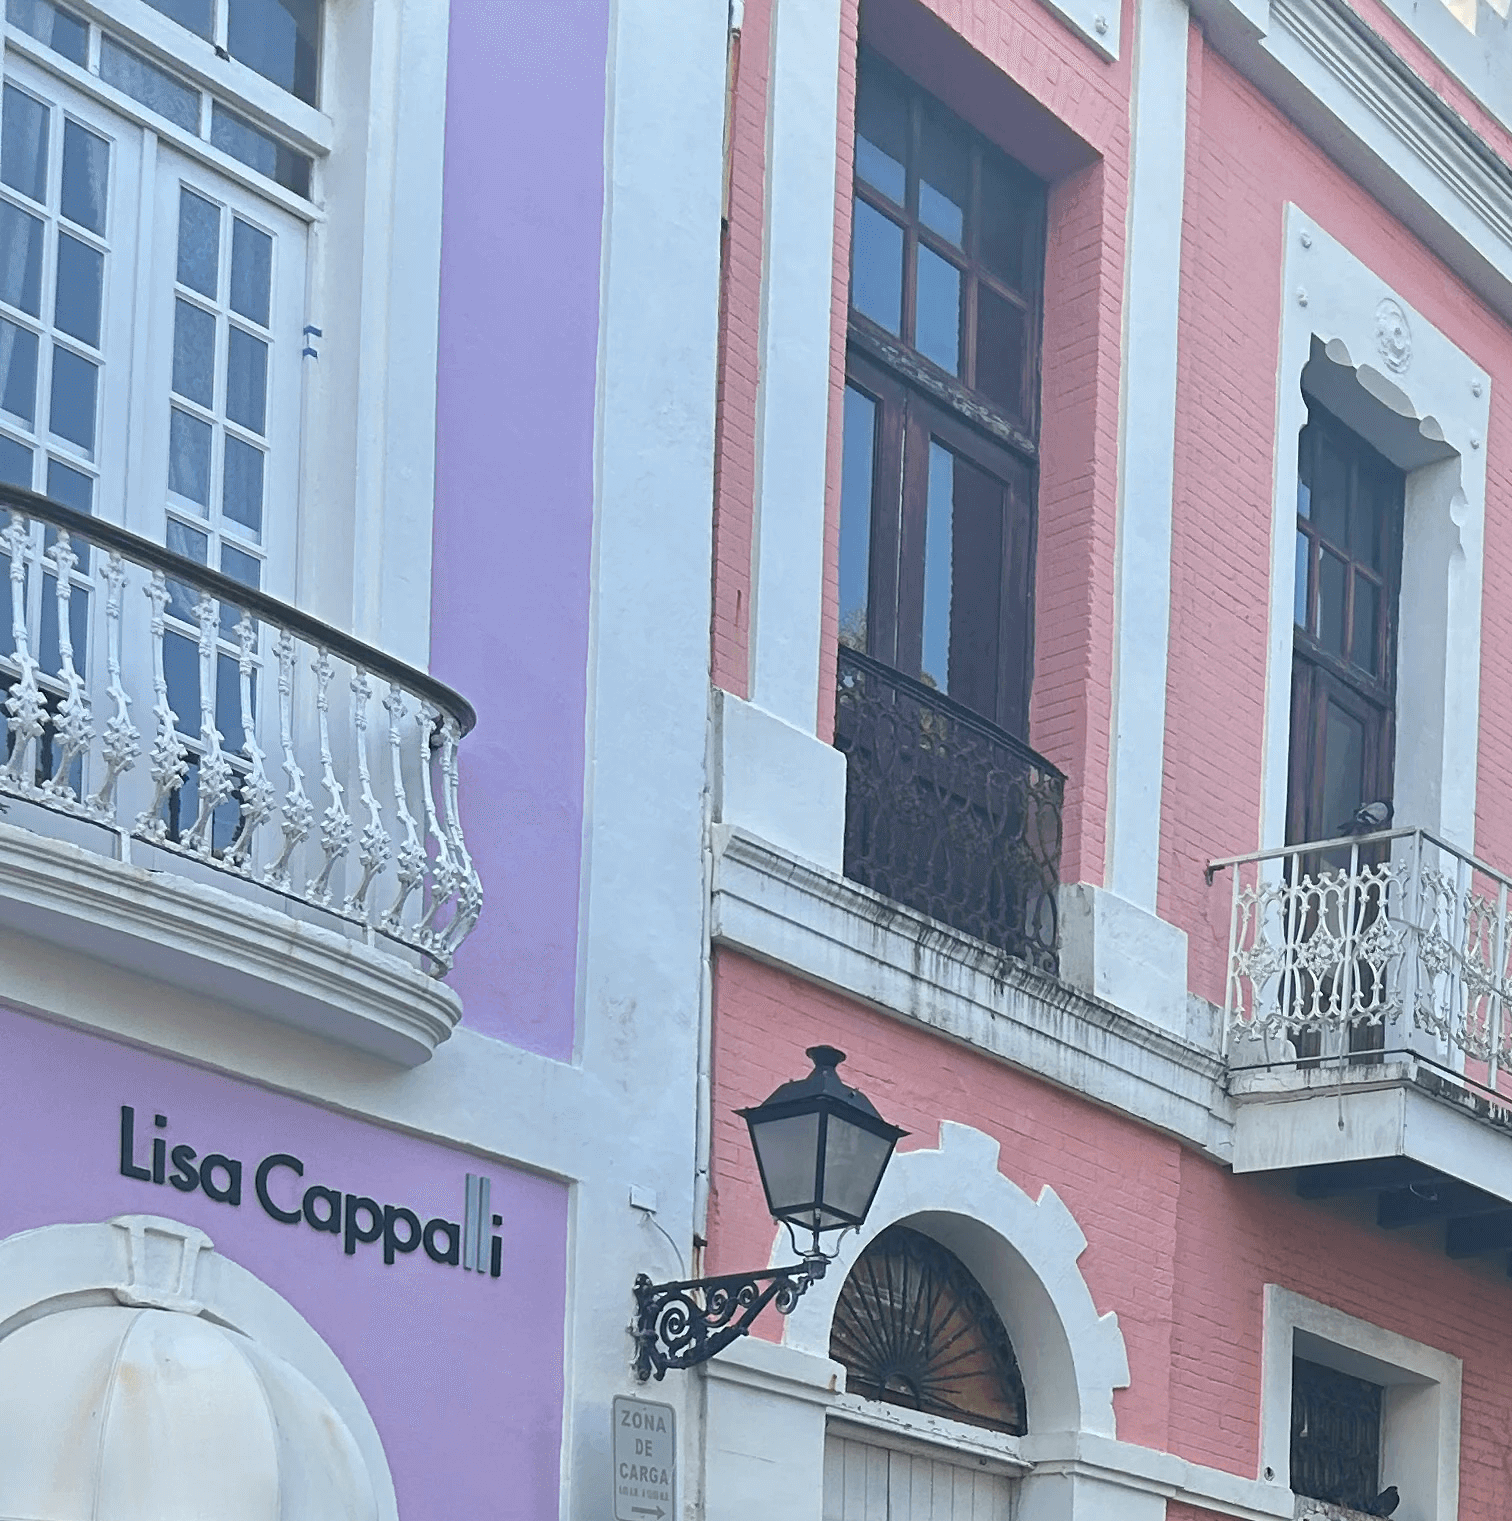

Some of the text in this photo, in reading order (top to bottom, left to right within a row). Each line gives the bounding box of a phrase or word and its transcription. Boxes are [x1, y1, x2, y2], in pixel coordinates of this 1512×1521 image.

[120, 1105, 503, 1277] Lisa Cappalli
[620, 1409, 667, 1434] ZONA
[635, 1438, 653, 1458] DE
[619, 1462, 669, 1486] CARGA
